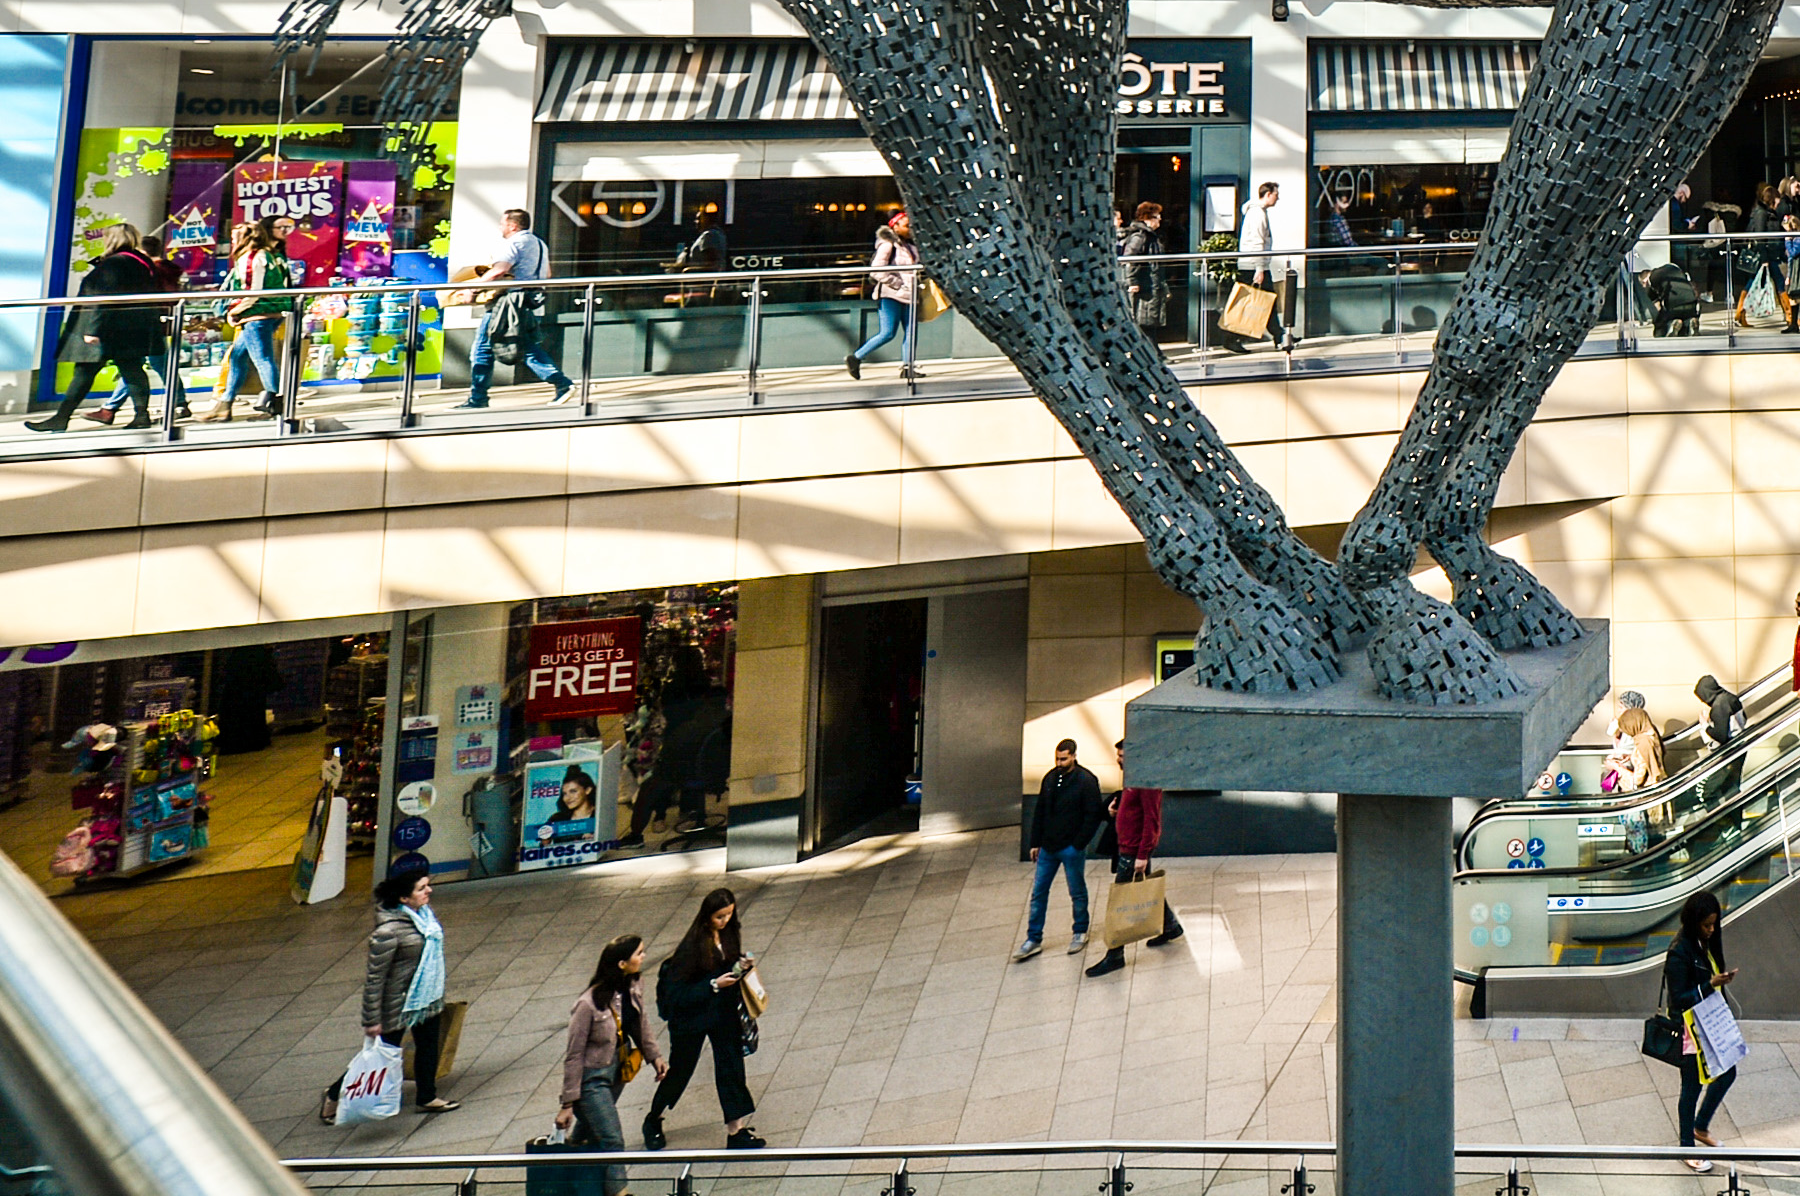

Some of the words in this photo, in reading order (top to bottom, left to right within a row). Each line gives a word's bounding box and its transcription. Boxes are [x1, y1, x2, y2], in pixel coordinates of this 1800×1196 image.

[237, 175, 334, 197] HOTTEST
[238, 192, 334, 222] TOYS
[172, 225, 215, 239] NEW
[347, 222, 389, 233] NEW
[732, 255, 783, 268] CÔTE
[556, 632, 614, 651] EVERYTHING
[540, 653, 570, 666] BUY
[572, 652, 581, 663] 3
[584, 650, 612, 662] GET
[615, 648, 624, 660] 3
[528, 660, 634, 700] FREE
[531, 786, 560, 799] FREE
[346, 1067, 387, 1101] H&M
